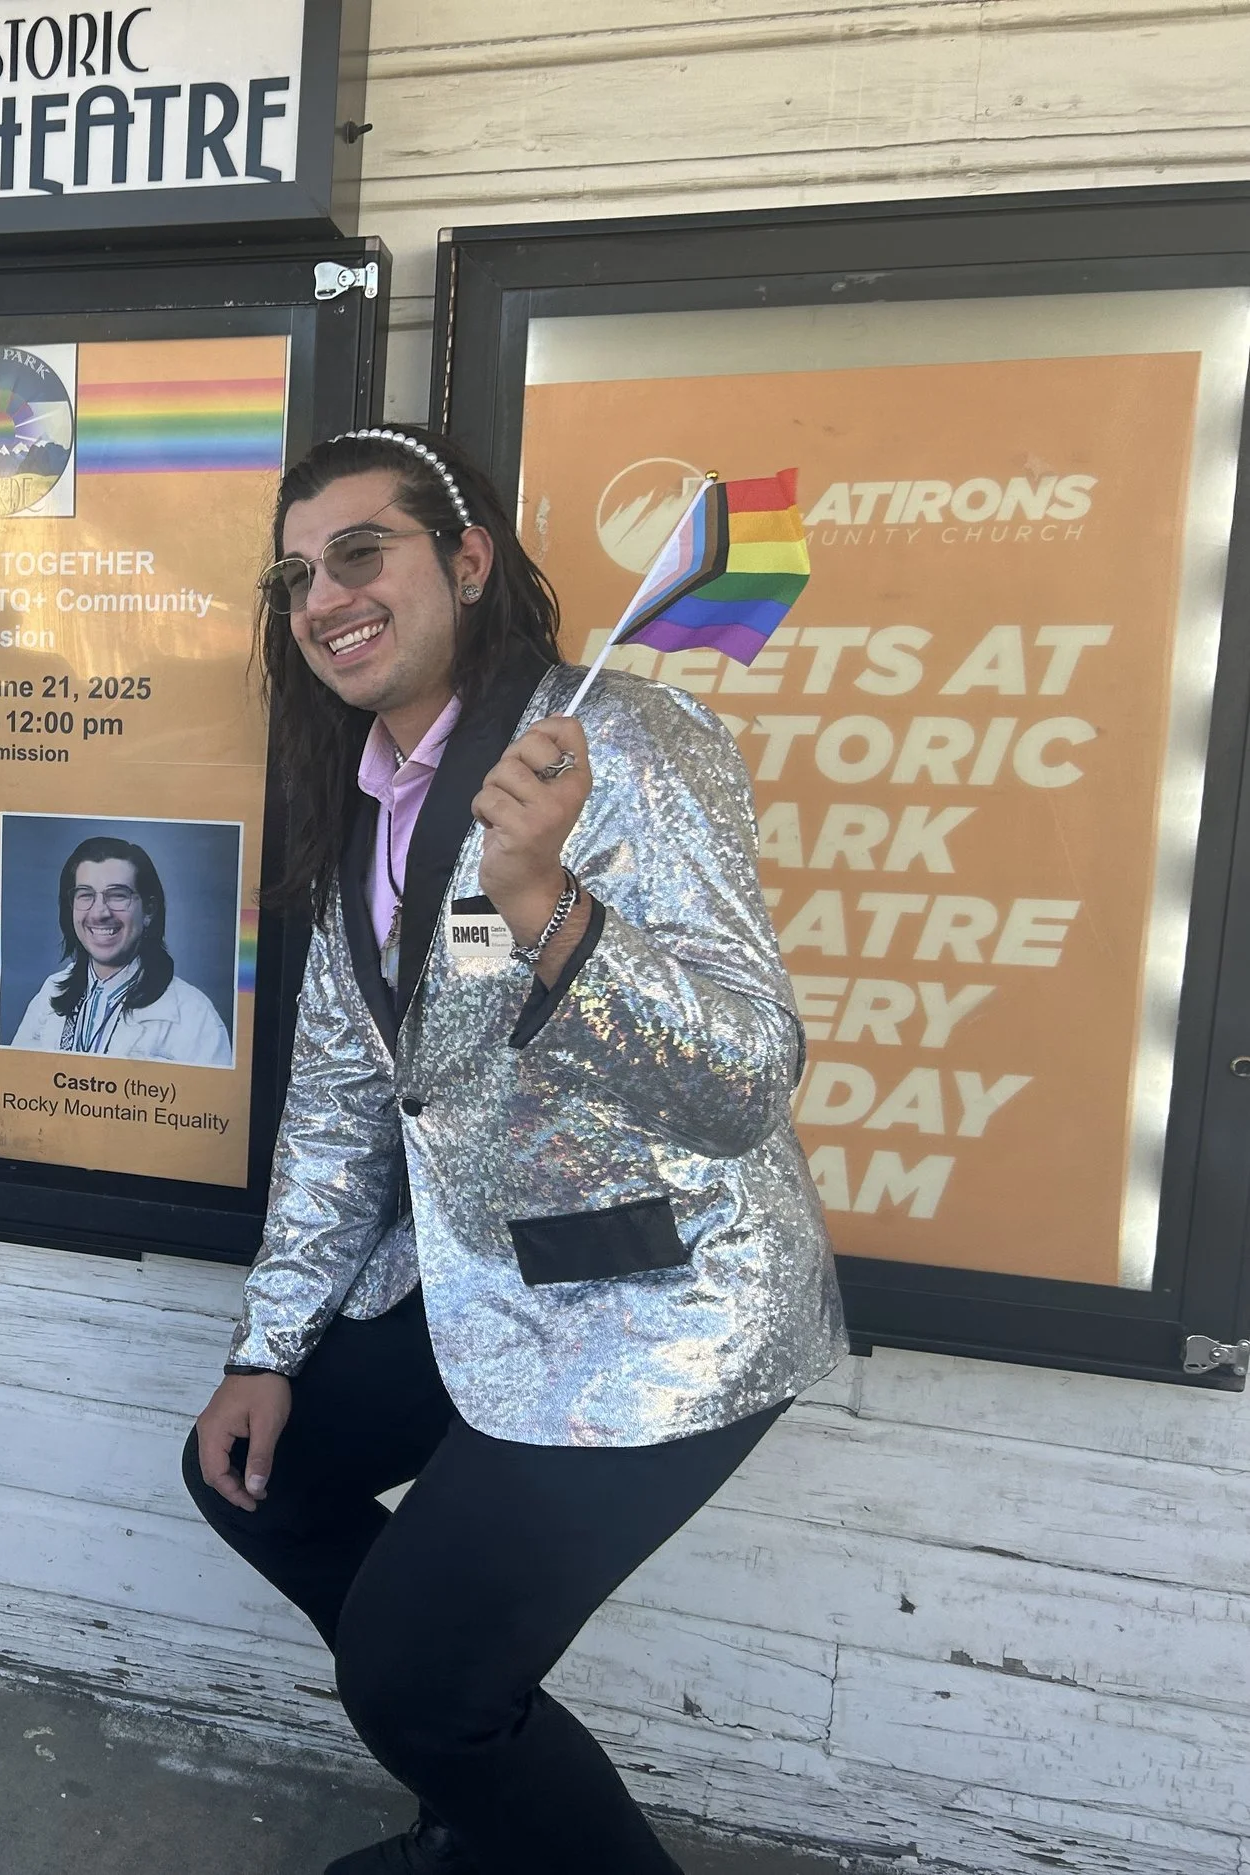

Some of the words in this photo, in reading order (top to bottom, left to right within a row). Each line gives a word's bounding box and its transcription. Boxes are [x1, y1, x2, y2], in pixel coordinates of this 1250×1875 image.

[3, 348, 50, 381] PARK
[801, 474, 1099, 525] ATIRONS
[941, 524, 1085, 544] CHURCH
[0, 550, 155, 575] TOGETHER
[56, 586, 212, 617] Community
[938, 625, 1114, 695] AT
[41, 676, 79, 703] 21,
[88, 676, 152, 701] 2025
[6, 709, 75, 734] 12:00
[83, 715, 124, 740] pm
[761, 888, 1081, 968] ATRE
[52, 1072, 118, 1095] Castro
[123, 1078, 178, 1104] (they)
[790, 1060, 1034, 1138] DAY
[2, 1092, 58, 1117] Rocky
[64, 1097, 148, 1124] Mountain
[154, 1107, 230, 1134] Equality
